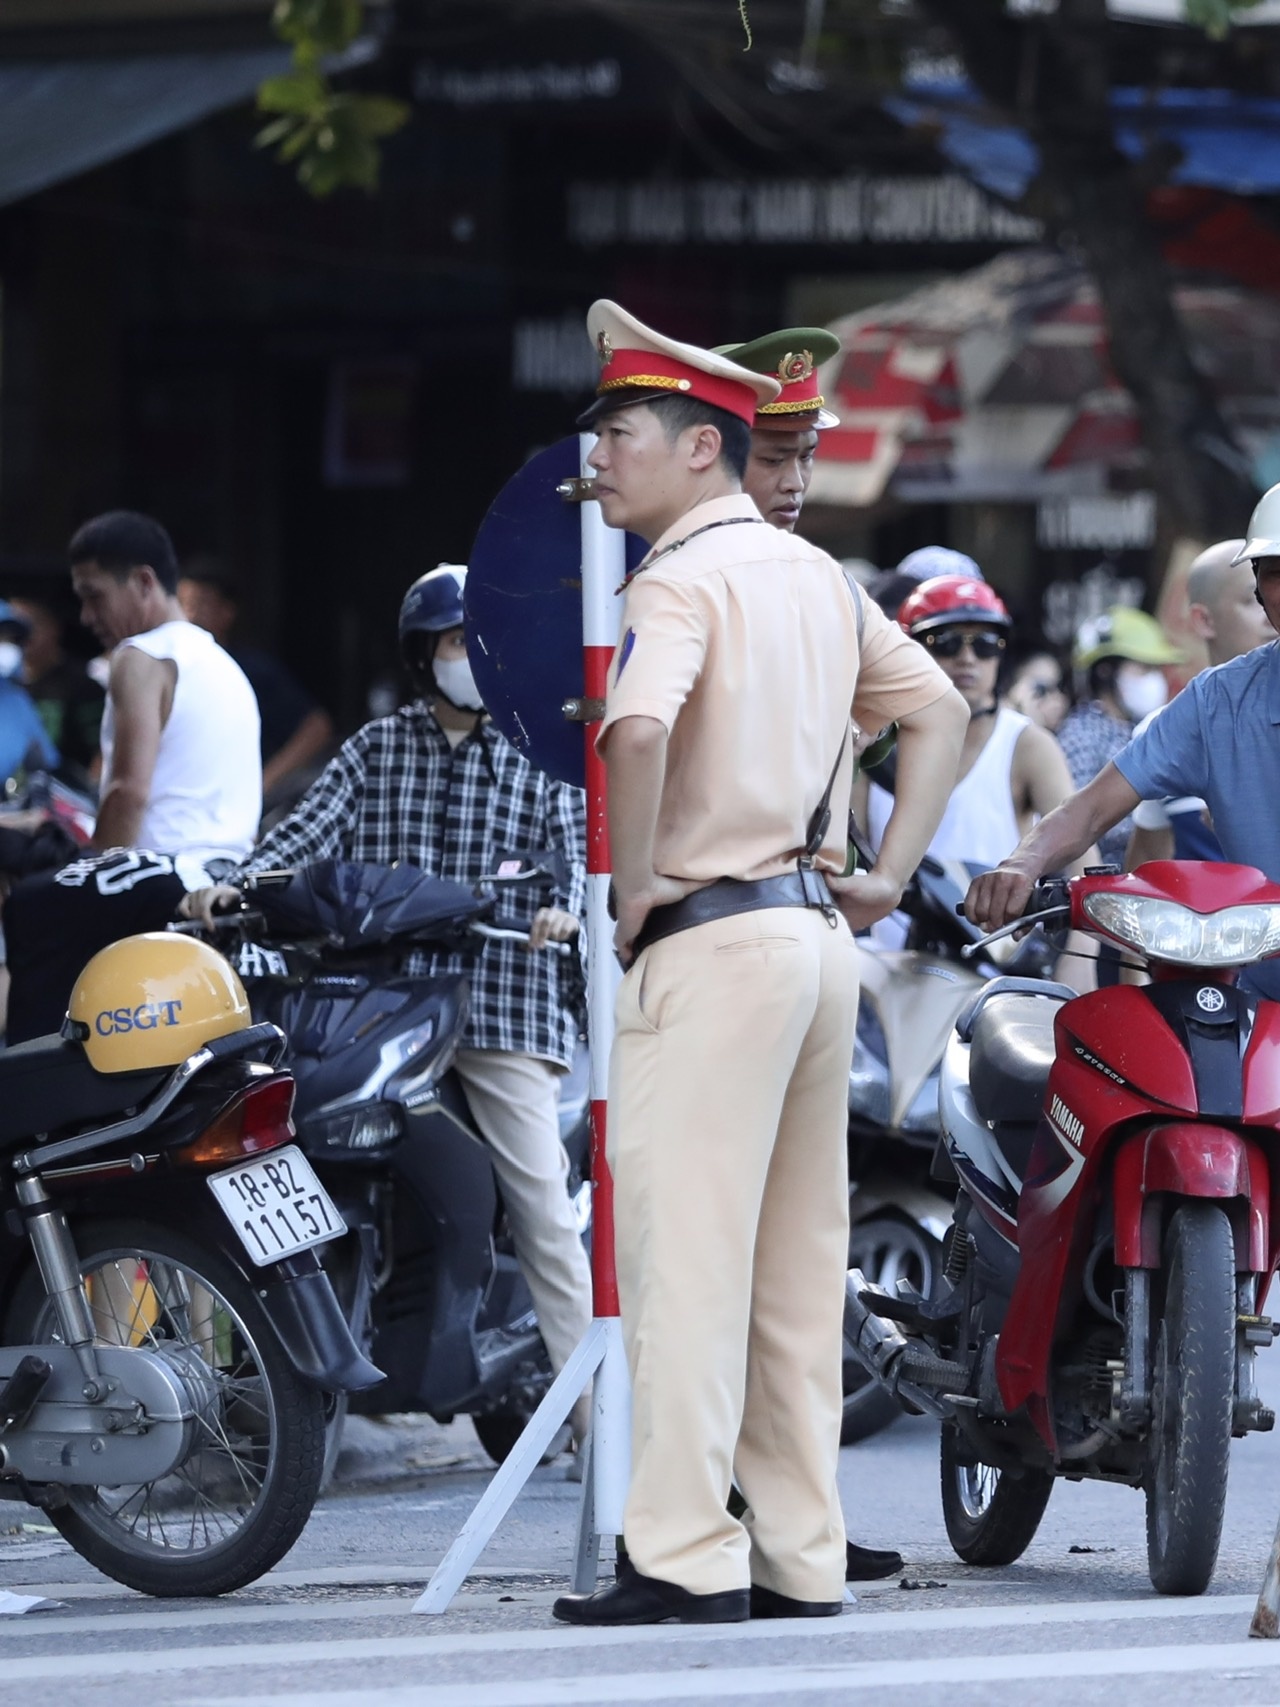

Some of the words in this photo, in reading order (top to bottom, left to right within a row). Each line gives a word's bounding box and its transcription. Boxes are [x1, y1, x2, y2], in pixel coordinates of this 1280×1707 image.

[95, 1000, 182, 1036] CSGT
[1050, 1093, 1085, 1147] YAMAHA
[229, 1159, 305, 1211] 18-B2
[244, 1194, 332, 1256] 111.57
